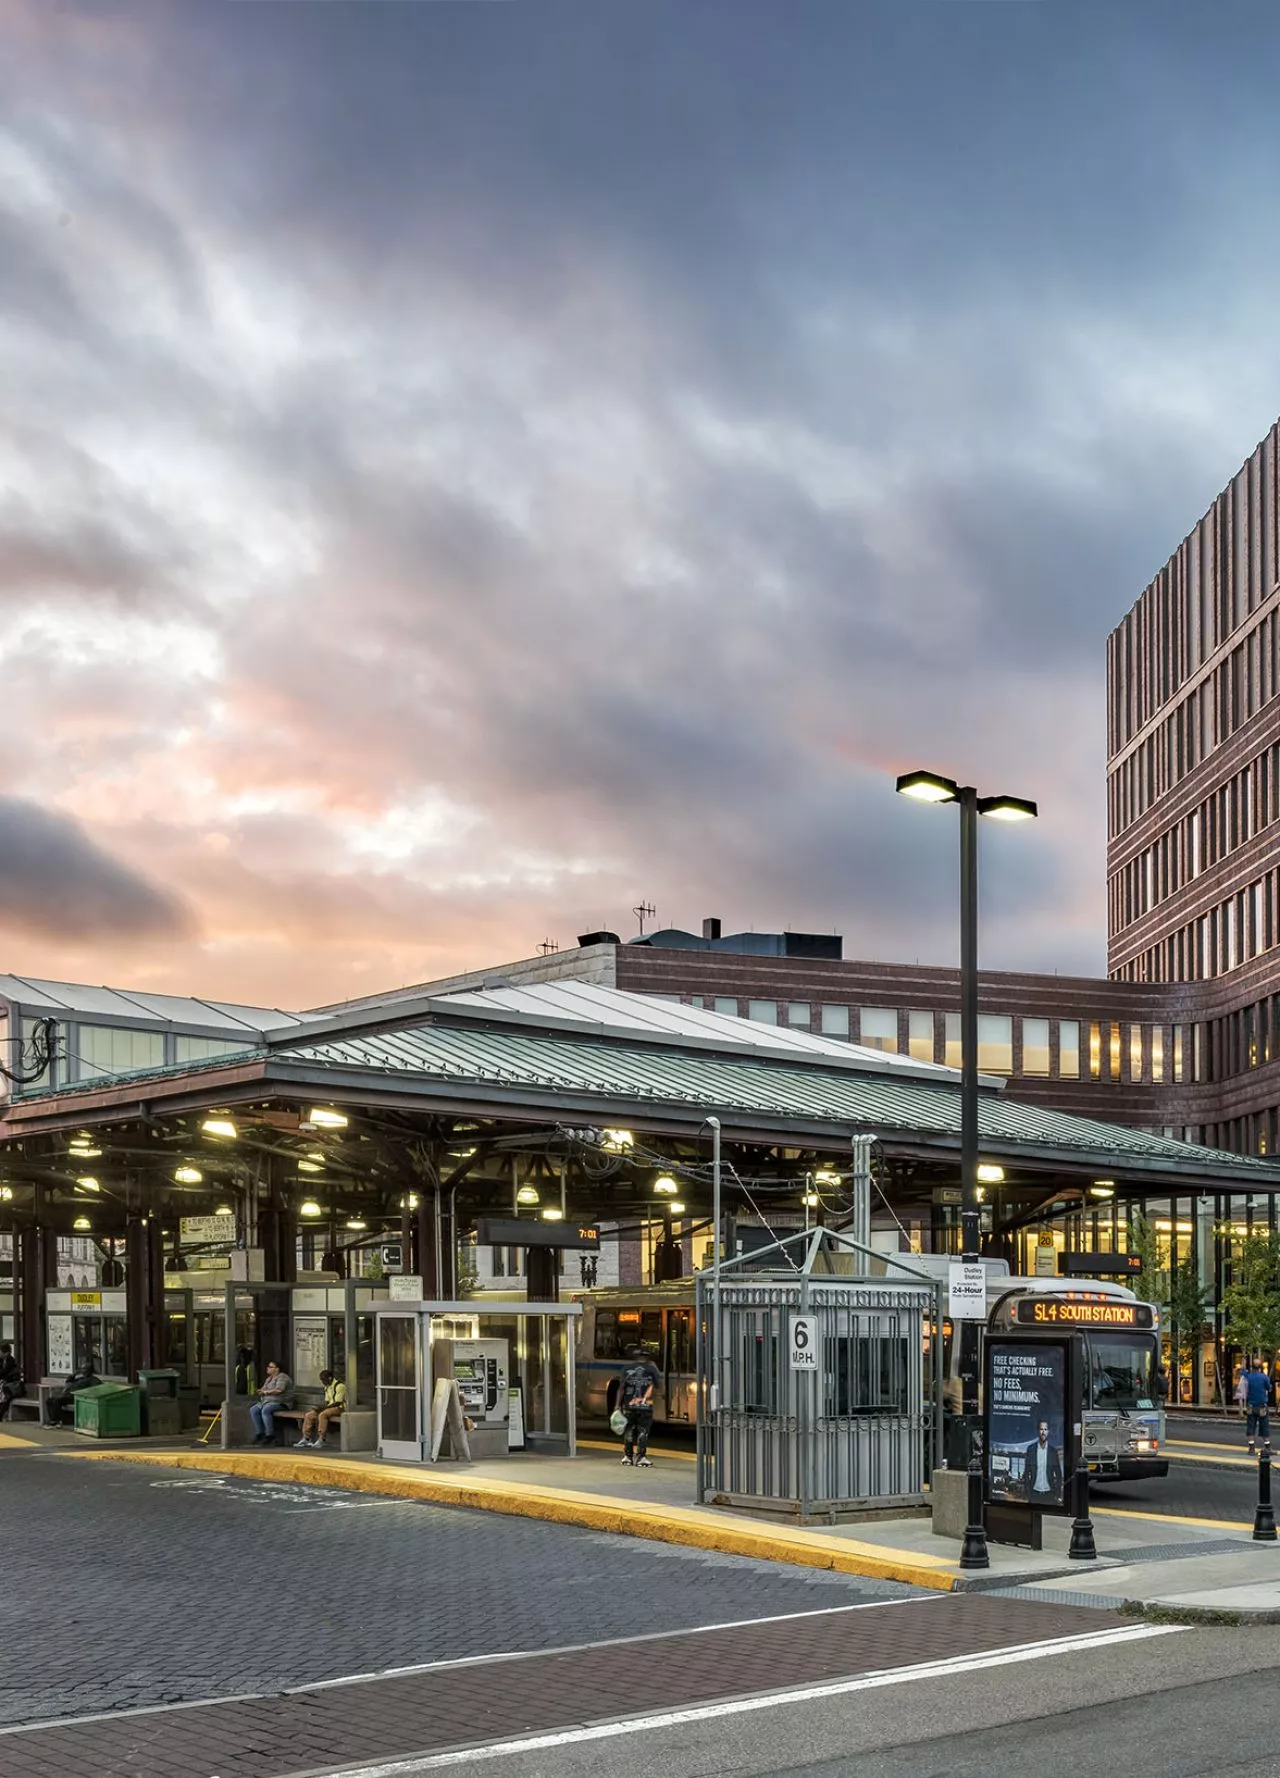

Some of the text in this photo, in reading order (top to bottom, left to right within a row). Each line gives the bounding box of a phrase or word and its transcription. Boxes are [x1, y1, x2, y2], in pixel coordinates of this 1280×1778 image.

[578, 1229, 596, 1239] 7:01
[1041, 1237, 1051, 1245] 20
[952, 1286, 983, 1294] 24-Hour
[1034, 1304, 1133, 1322] SL4 SOUTH STATION
[795, 1321, 808, 1349] 6
[993, 1355, 1036, 1366] FREE CHECKING
[993, 1366, 1010, 1375] THAT'S
[1011, 1367, 1037, 1376] ACTUALLY
[993, 1378, 1021, 1390] NO FEES,
[993, 1390, 1040, 1403] NO MINIMUMS.
